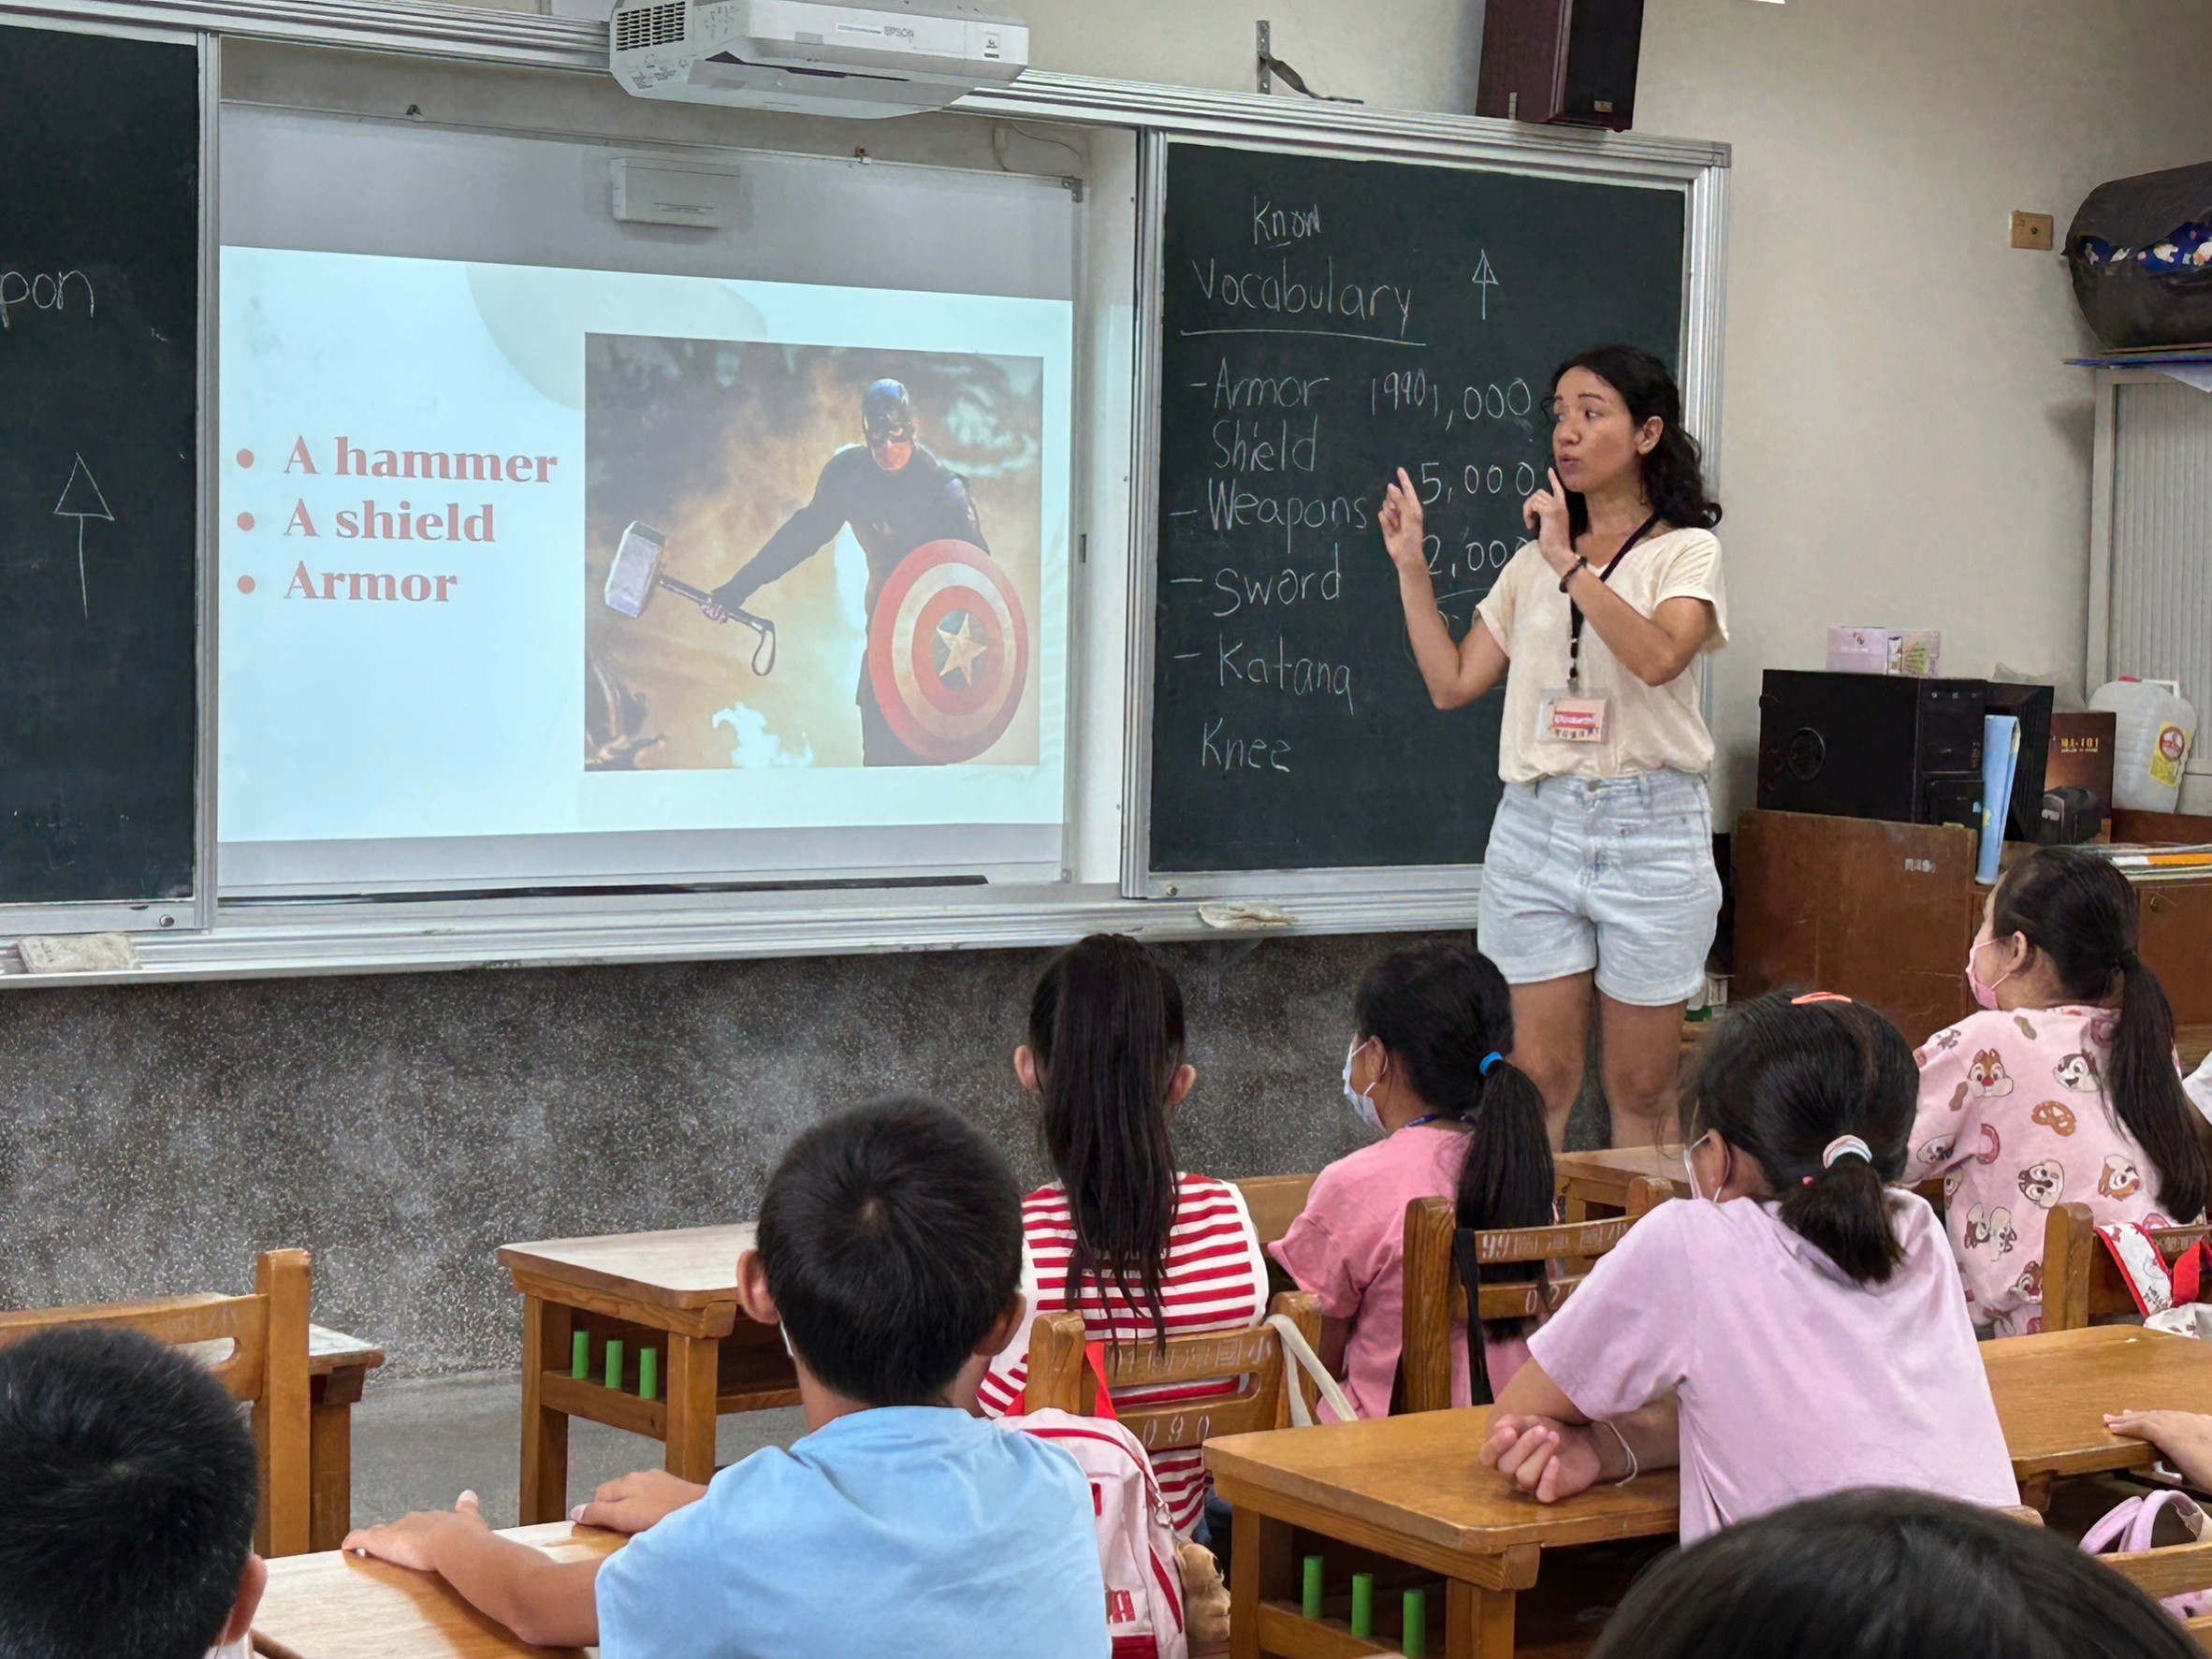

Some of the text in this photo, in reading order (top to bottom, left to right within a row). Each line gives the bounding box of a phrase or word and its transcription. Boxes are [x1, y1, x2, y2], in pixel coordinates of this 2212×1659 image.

[1253, 195, 1321, 245] Know
[0, 269, 95, 327] pon
[1191, 255, 1412, 339] Vocabulary
[1214, 357, 1330, 410] Armor
[284, 435, 559, 483] A hammer
[1213, 414, 1318, 472] Shield
[1421, 461, 1535, 505] 5,000
[284, 498, 496, 542] A shield
[1208, 477, 1368, 554] Weapons
[284, 560, 458, 602] Armor
[1213, 543, 1342, 617] Sword
[1422, 534, 1527, 578] 2,00
[1201, 718, 1291, 772] Knee
